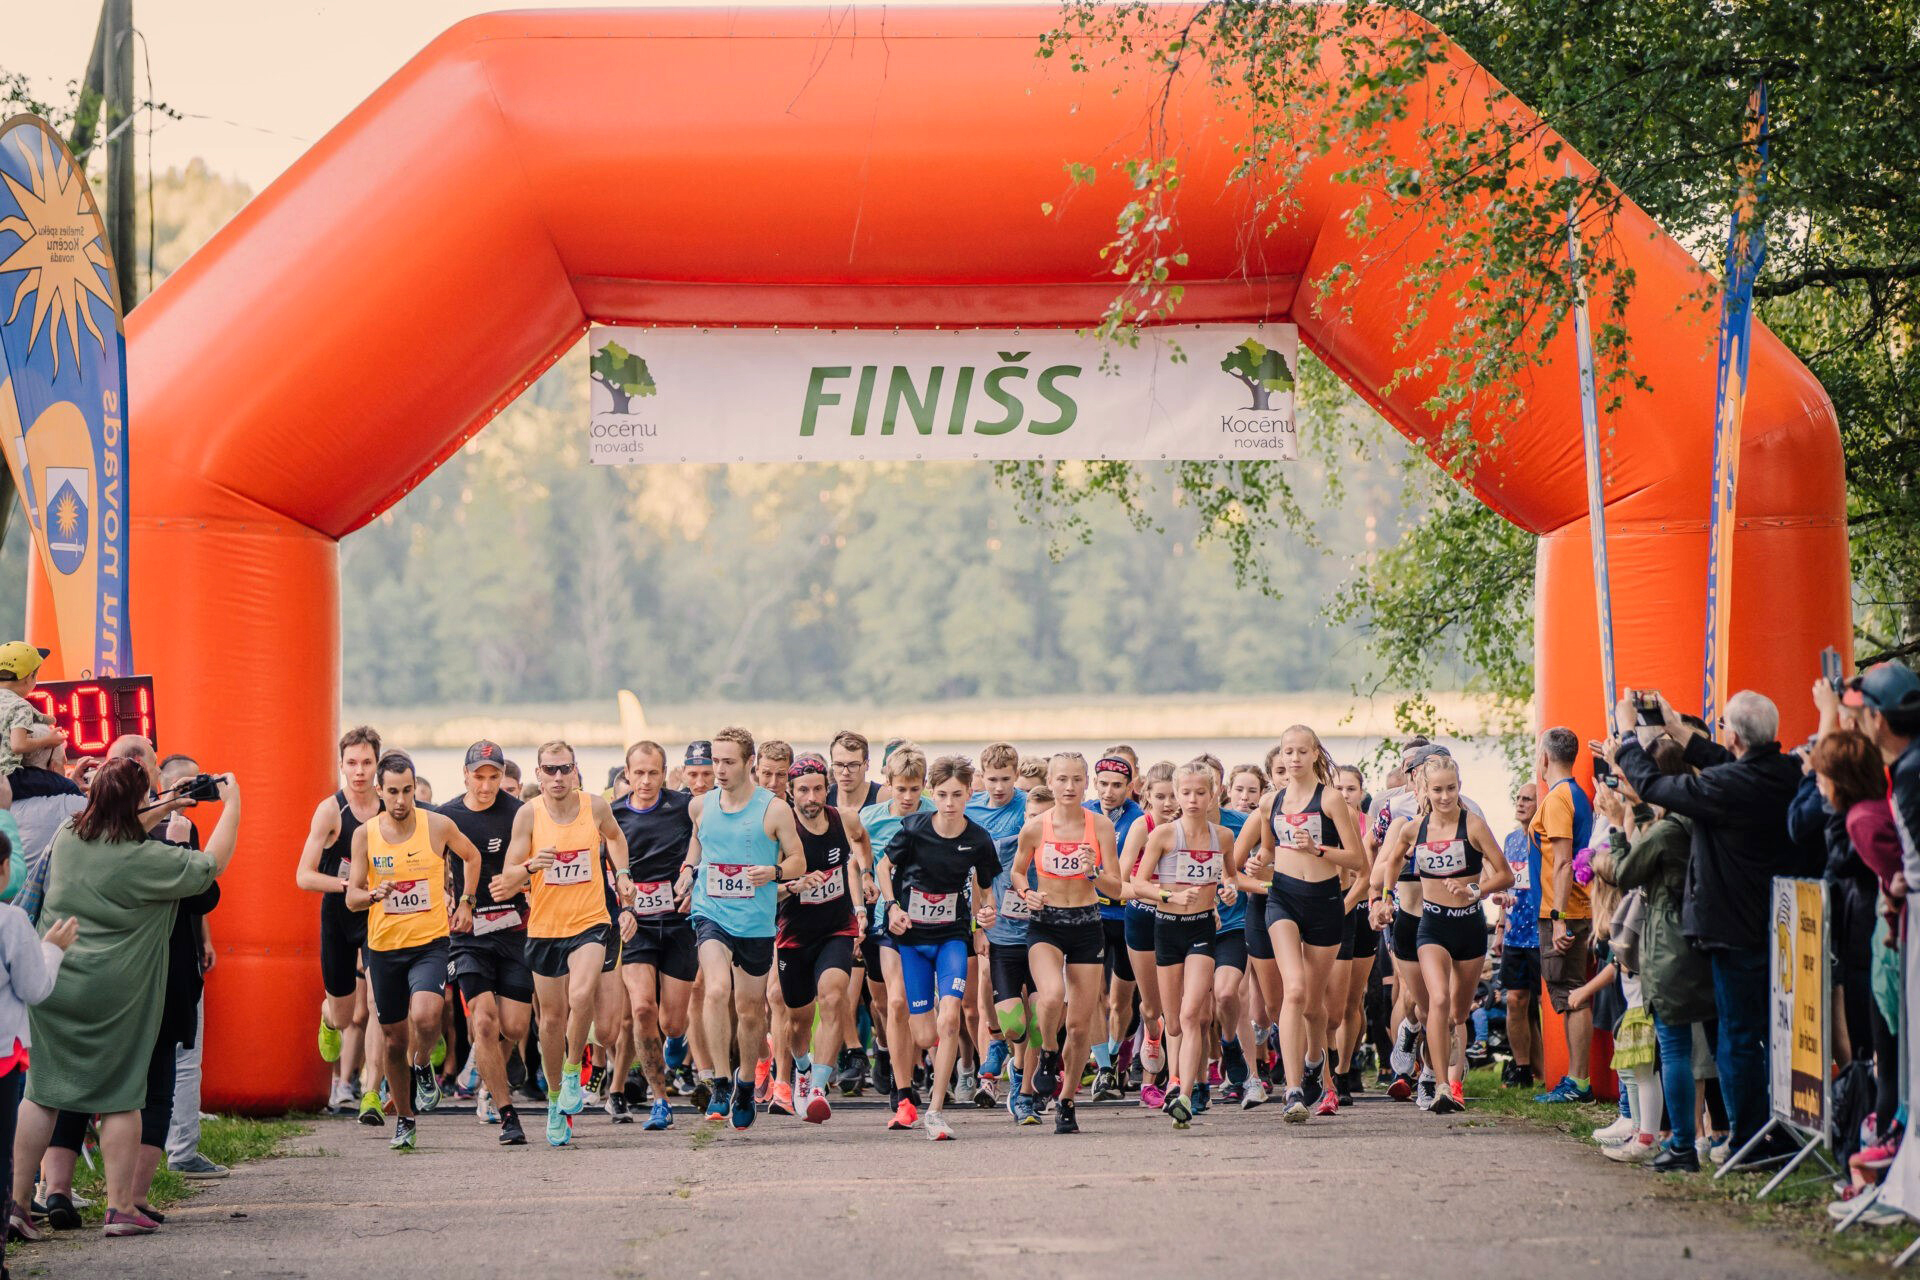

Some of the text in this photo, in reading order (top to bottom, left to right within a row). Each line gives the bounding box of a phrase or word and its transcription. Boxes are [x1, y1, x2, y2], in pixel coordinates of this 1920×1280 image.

[799, 351, 1083, 437] FINIŠS
[590, 420, 658, 438] ocēnu
[1221, 415, 1296, 434] Kocēnu
[595, 440, 644, 453] novads
[1234, 436, 1284, 449] novads
[1052, 857, 1079, 869] 128
[1426, 855, 1454, 869] 232
[554, 864, 581, 878] 177
[1187, 865, 1212, 878] 231
[717, 878, 744, 891] 184
[811, 882, 835, 899] 210
[393, 894, 419, 907] 140
[637, 895, 663, 908] 235
[920, 905, 945, 917] 179
[1446, 905, 1477, 917] NIKE
